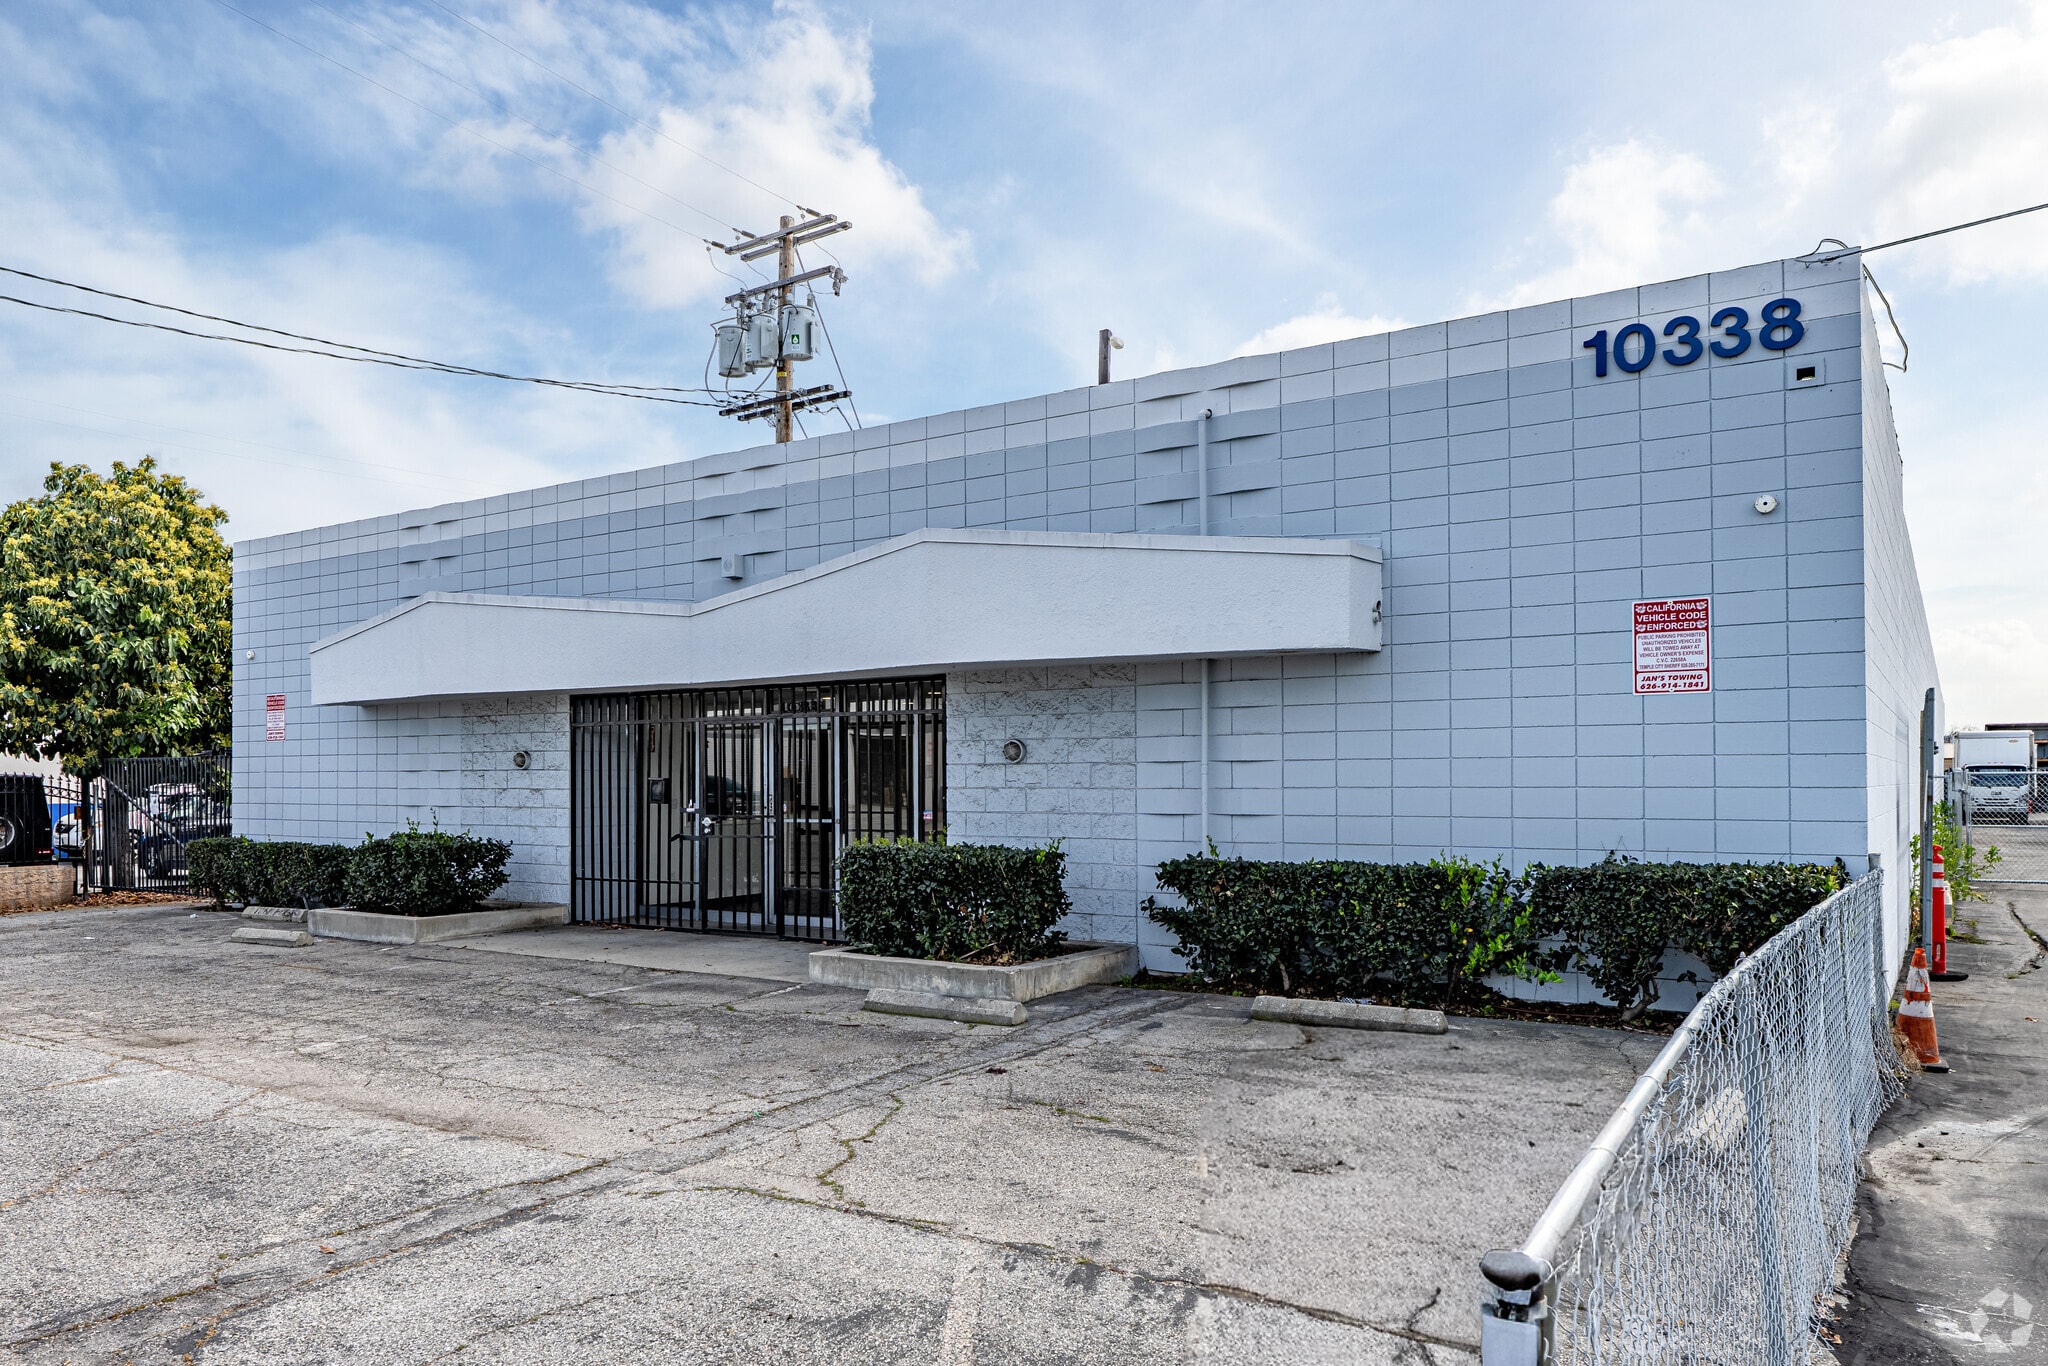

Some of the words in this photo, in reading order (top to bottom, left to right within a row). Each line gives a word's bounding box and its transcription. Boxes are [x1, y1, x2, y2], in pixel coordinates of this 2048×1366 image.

[1583, 298, 1804, 377] 10338
[1647, 603, 1696, 612] CALIFORNIA
[1637, 613, 1676, 622] VEHICLE
[1679, 611, 1706, 619] CODE
[1647, 622, 1696, 630] ENFORCED
